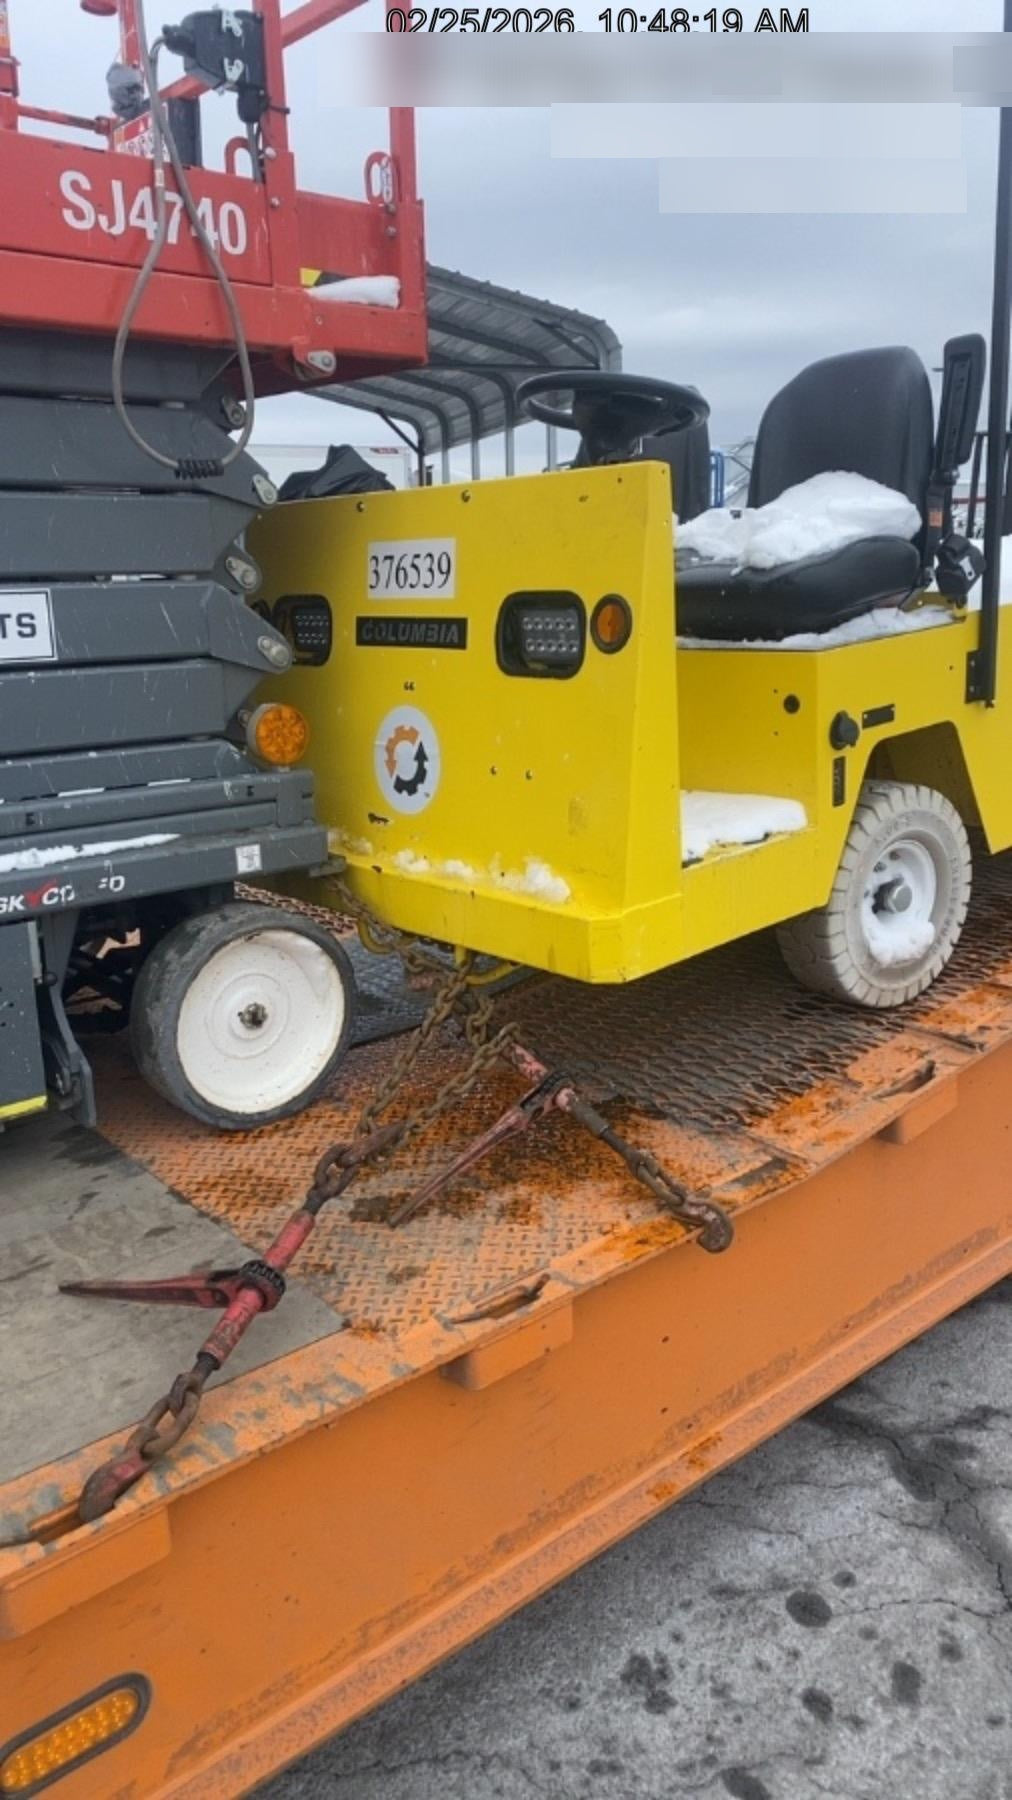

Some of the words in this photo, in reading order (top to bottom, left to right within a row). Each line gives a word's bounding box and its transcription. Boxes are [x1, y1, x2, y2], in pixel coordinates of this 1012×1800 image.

[59, 169, 248, 255] SJ4740
[369, 551, 452, 589] 376539
[362, 621, 460, 643] COLUMBIA
